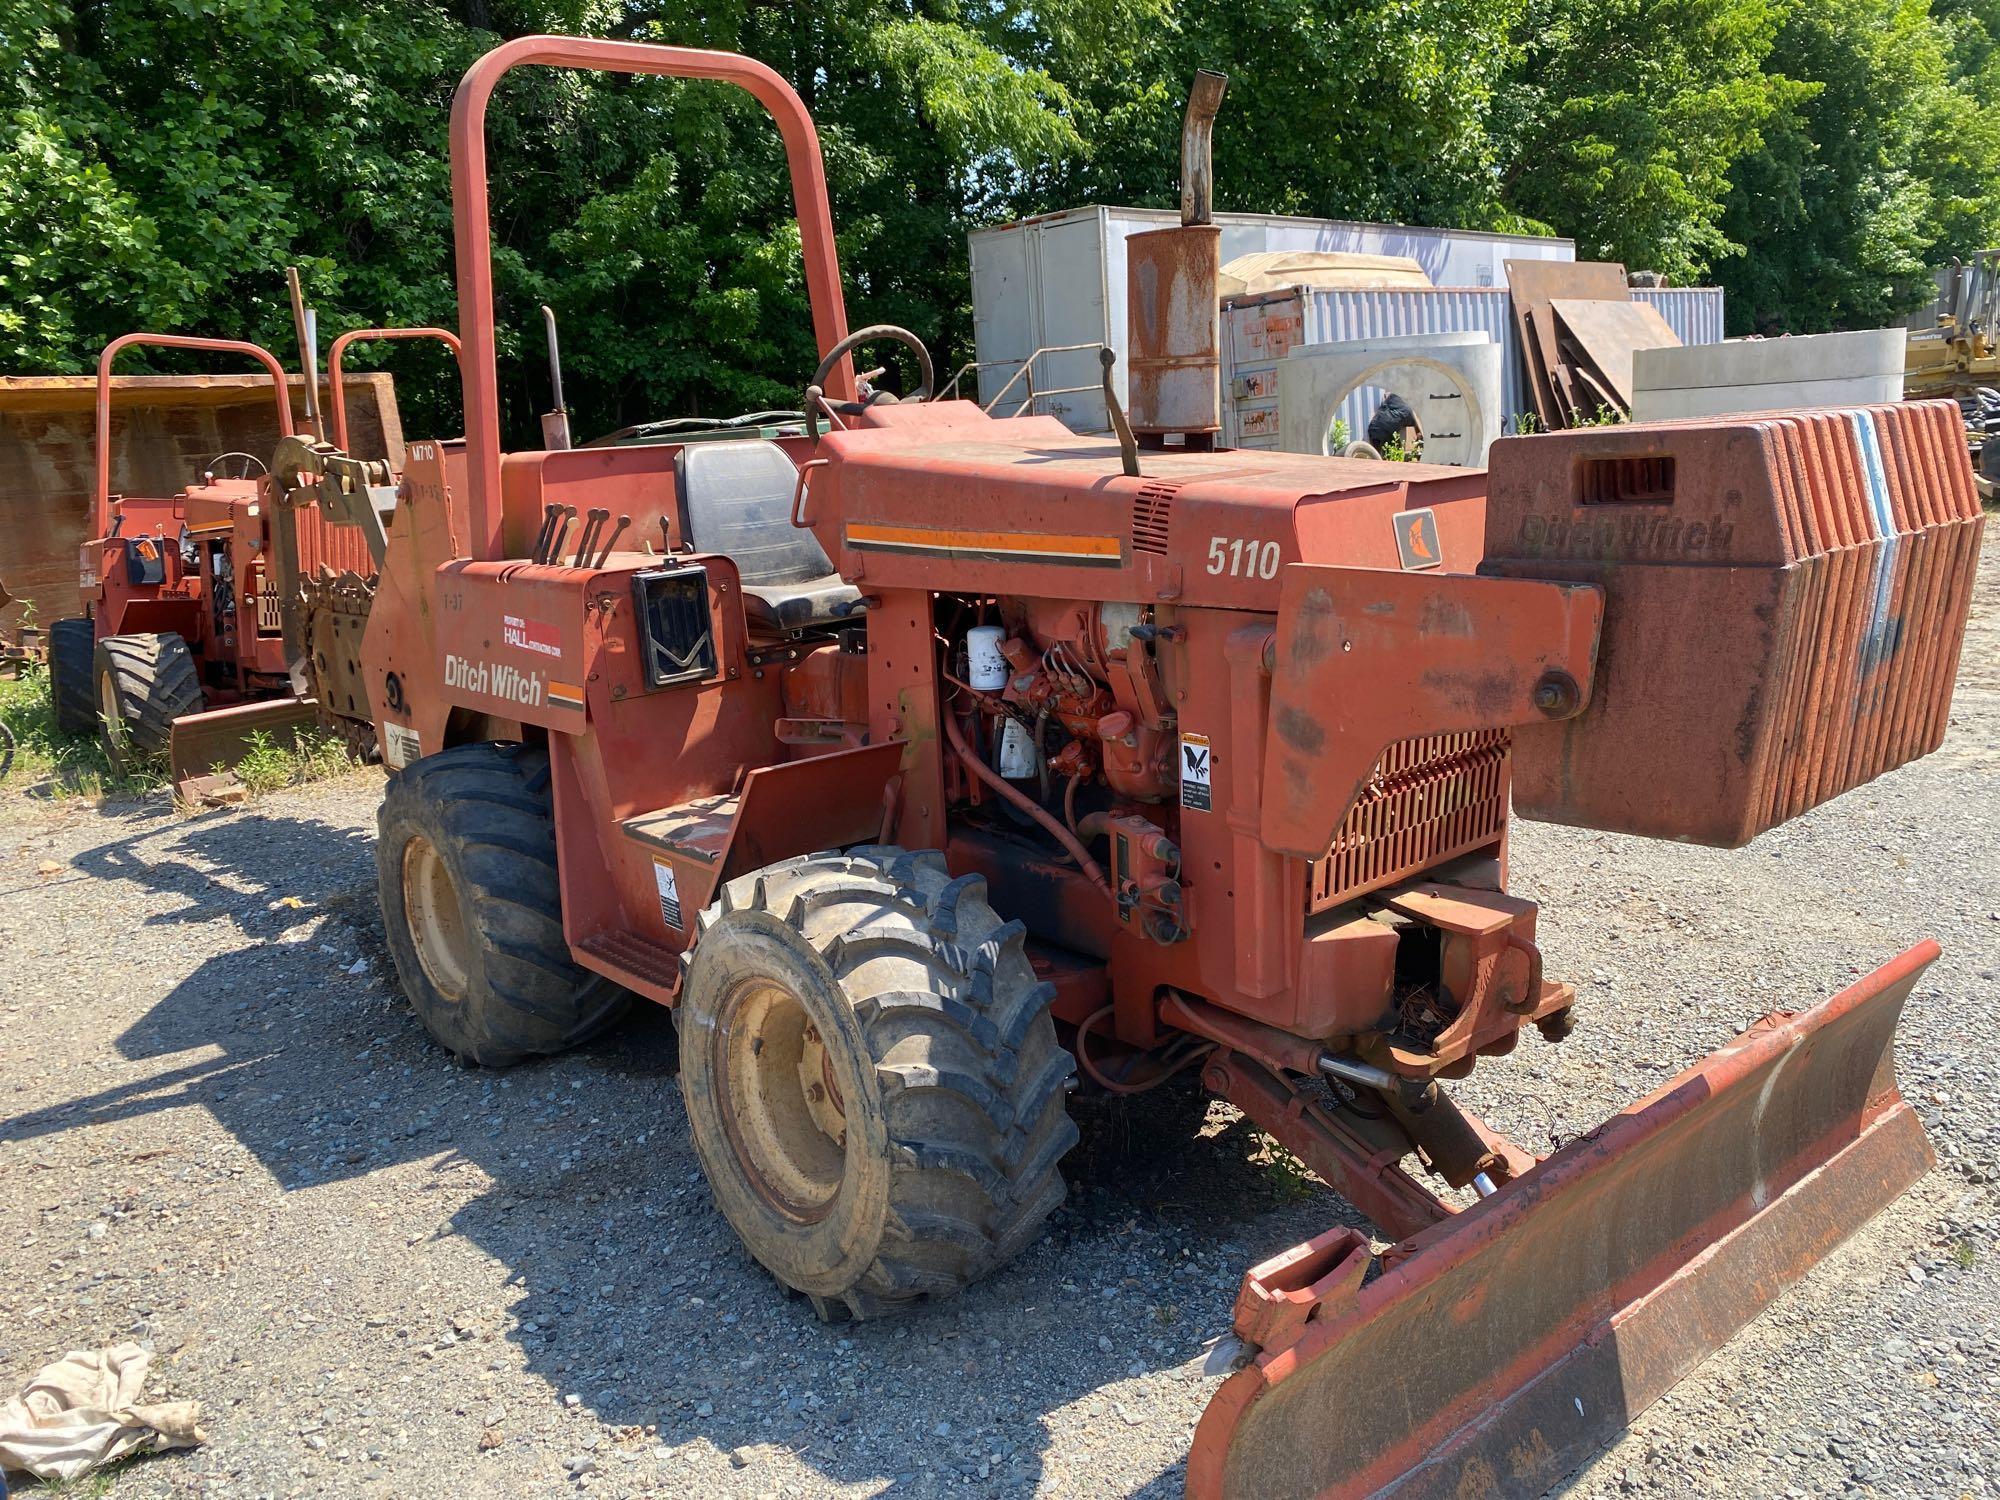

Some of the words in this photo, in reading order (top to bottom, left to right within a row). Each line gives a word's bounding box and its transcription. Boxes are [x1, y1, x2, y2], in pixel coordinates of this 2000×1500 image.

[412, 444, 434, 461] M710
[1206, 536, 1281, 580] 5110
[444, 654, 488, 695] Ditch
[491, 663, 542, 707] Witch
